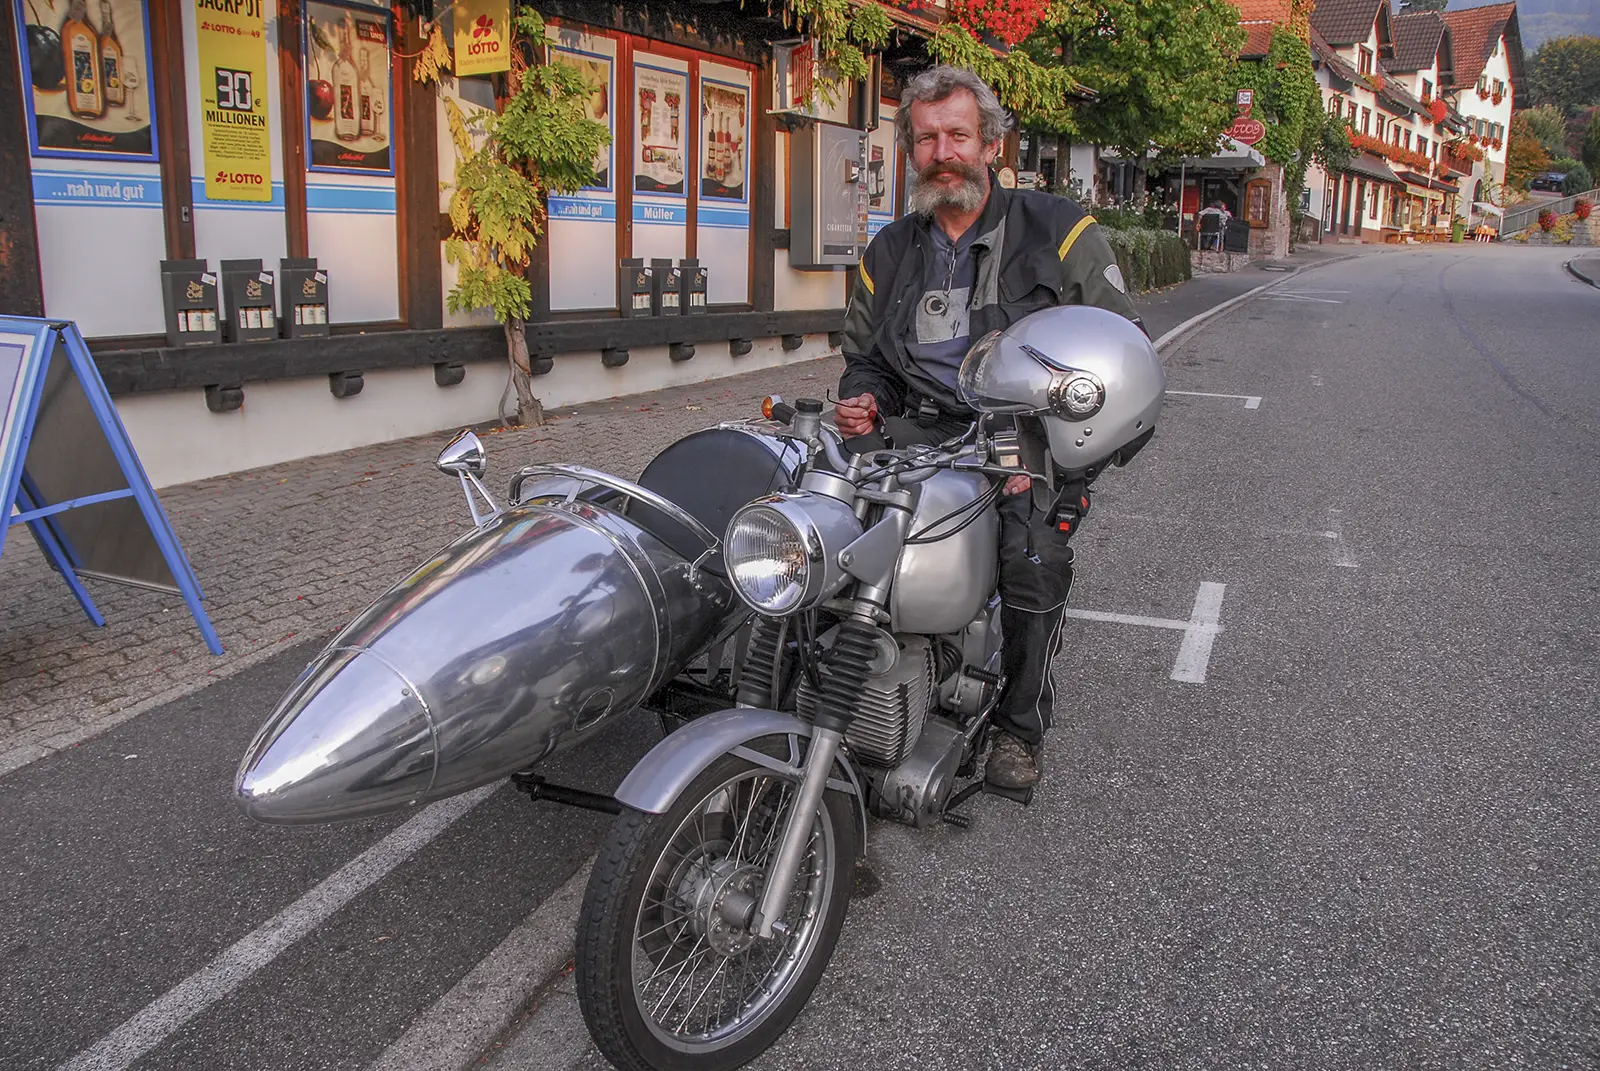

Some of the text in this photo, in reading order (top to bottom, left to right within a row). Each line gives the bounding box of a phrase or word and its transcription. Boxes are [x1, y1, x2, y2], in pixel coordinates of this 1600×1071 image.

[211, 23, 235, 34] LOTTO
[237, 27, 242, 35] 6
[251, 30, 260, 38] 49
[467, 41, 499, 55] LOTTO
[217, 70, 251, 109] 30
[254, 98, 262, 107] €
[206, 110, 265, 126] MILLIONEN
[230, 173, 263, 185] LOTTO
[96, 182, 121, 198] und
[122, 184, 145, 201] gut
[578, 204, 591, 215] und
[591, 206, 603, 217] gut
[643, 207, 675, 220] Müller
